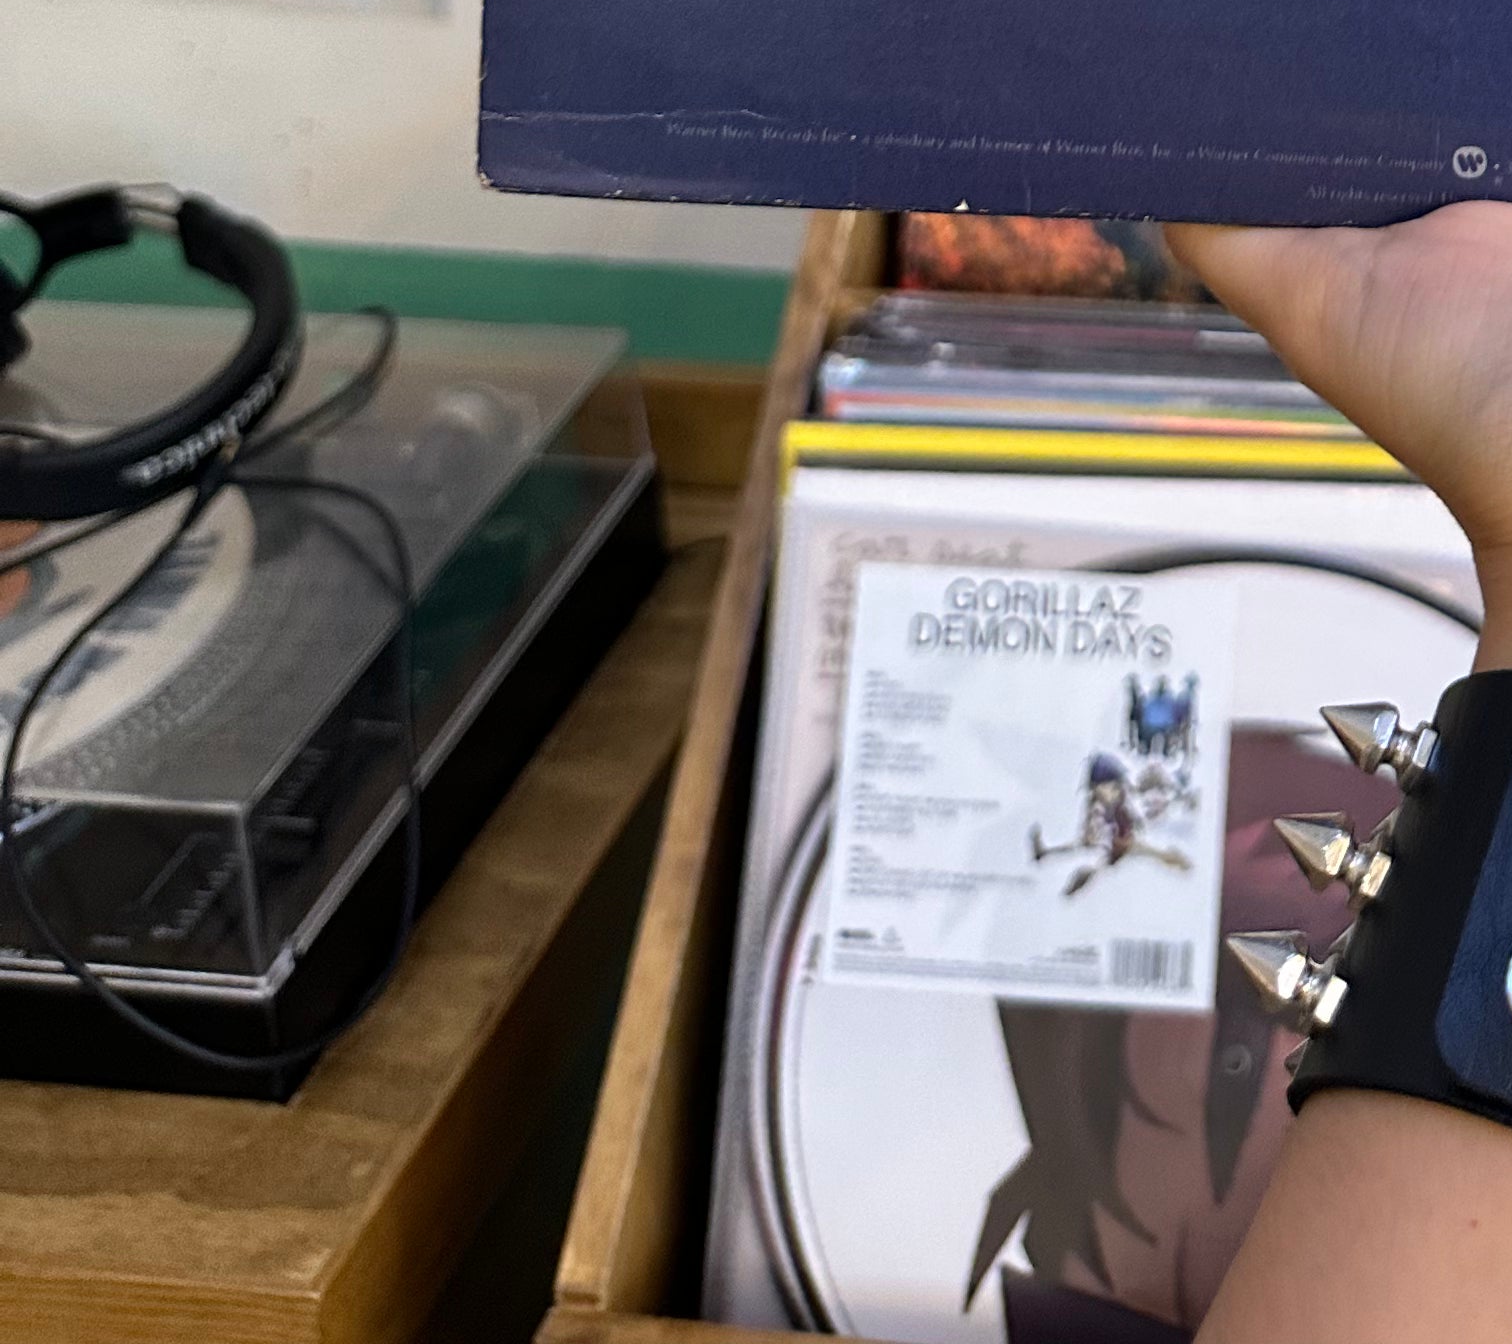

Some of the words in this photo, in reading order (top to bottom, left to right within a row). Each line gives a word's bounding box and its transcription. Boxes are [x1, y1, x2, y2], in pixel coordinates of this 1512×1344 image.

[945, 577, 1143, 620] GORILLAZ
[909, 611, 1056, 657] DEMON
[1068, 619, 1174, 663] DAYS
